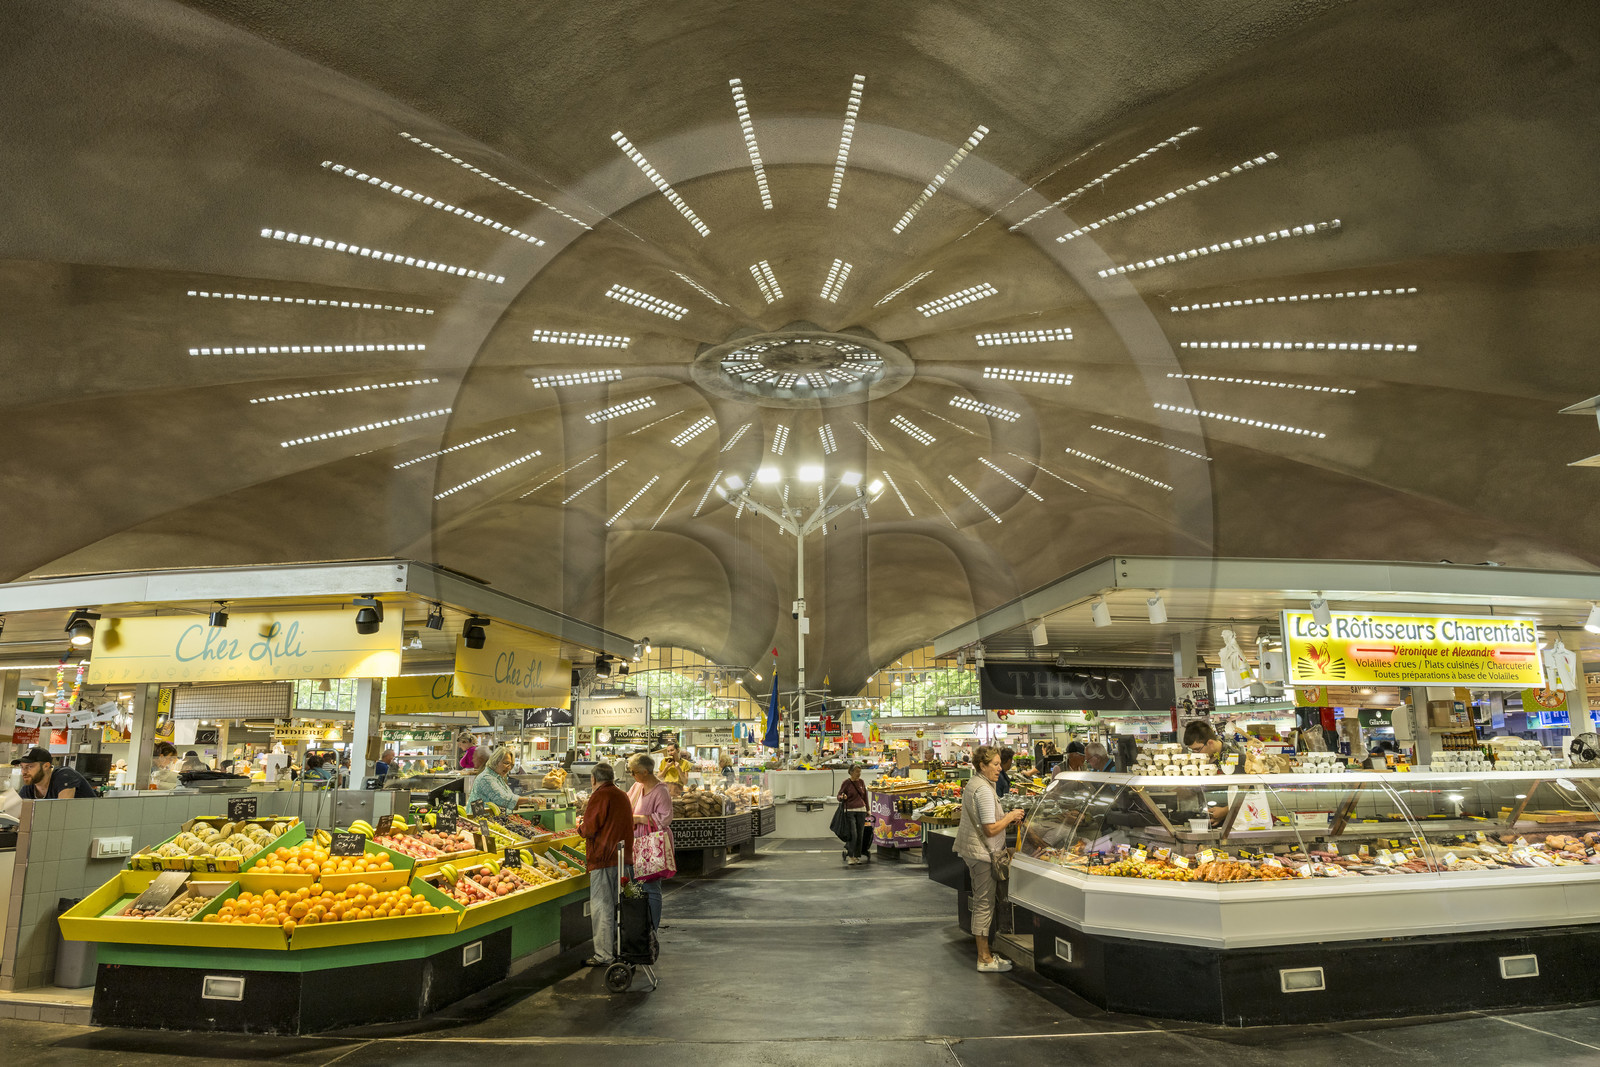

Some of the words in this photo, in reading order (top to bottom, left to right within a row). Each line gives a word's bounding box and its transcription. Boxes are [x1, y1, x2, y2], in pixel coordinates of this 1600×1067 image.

[1296, 617, 1329, 637] Les
[1336, 617, 1436, 640] Rôtisseurs
[1442, 621, 1535, 642] Charentais
[175, 621, 242, 662] Chez
[249, 620, 307, 665] Lili
[1393, 645, 1438, 658] Véronique
[1440, 647, 1449, 656] et
[1452, 647, 1496, 657] Alexandre
[495, 651, 522, 686] Chez
[522, 659, 544, 690] Lili
[1356, 659, 1391, 668] Volailles
[1424, 660, 1445, 668] Plats
[1447, 661, 1480, 670] cuisinés
[1487, 661, 1532, 670] Charcuterie
[1374, 670, 1399, 679] Toutes
[1402, 671, 1450, 681] préparations
[1451, 671, 1456, 679] à
[1458, 671, 1475, 679] base
[1477, 671, 1487, 679] de
[1008, 671, 1078, 700] THE
[1080, 673, 1105, 700] &
[591, 707, 606, 715] PAIN
[613, 729, 660, 738] FROMAGERIE
[673, 830, 712, 838] TRADITION
